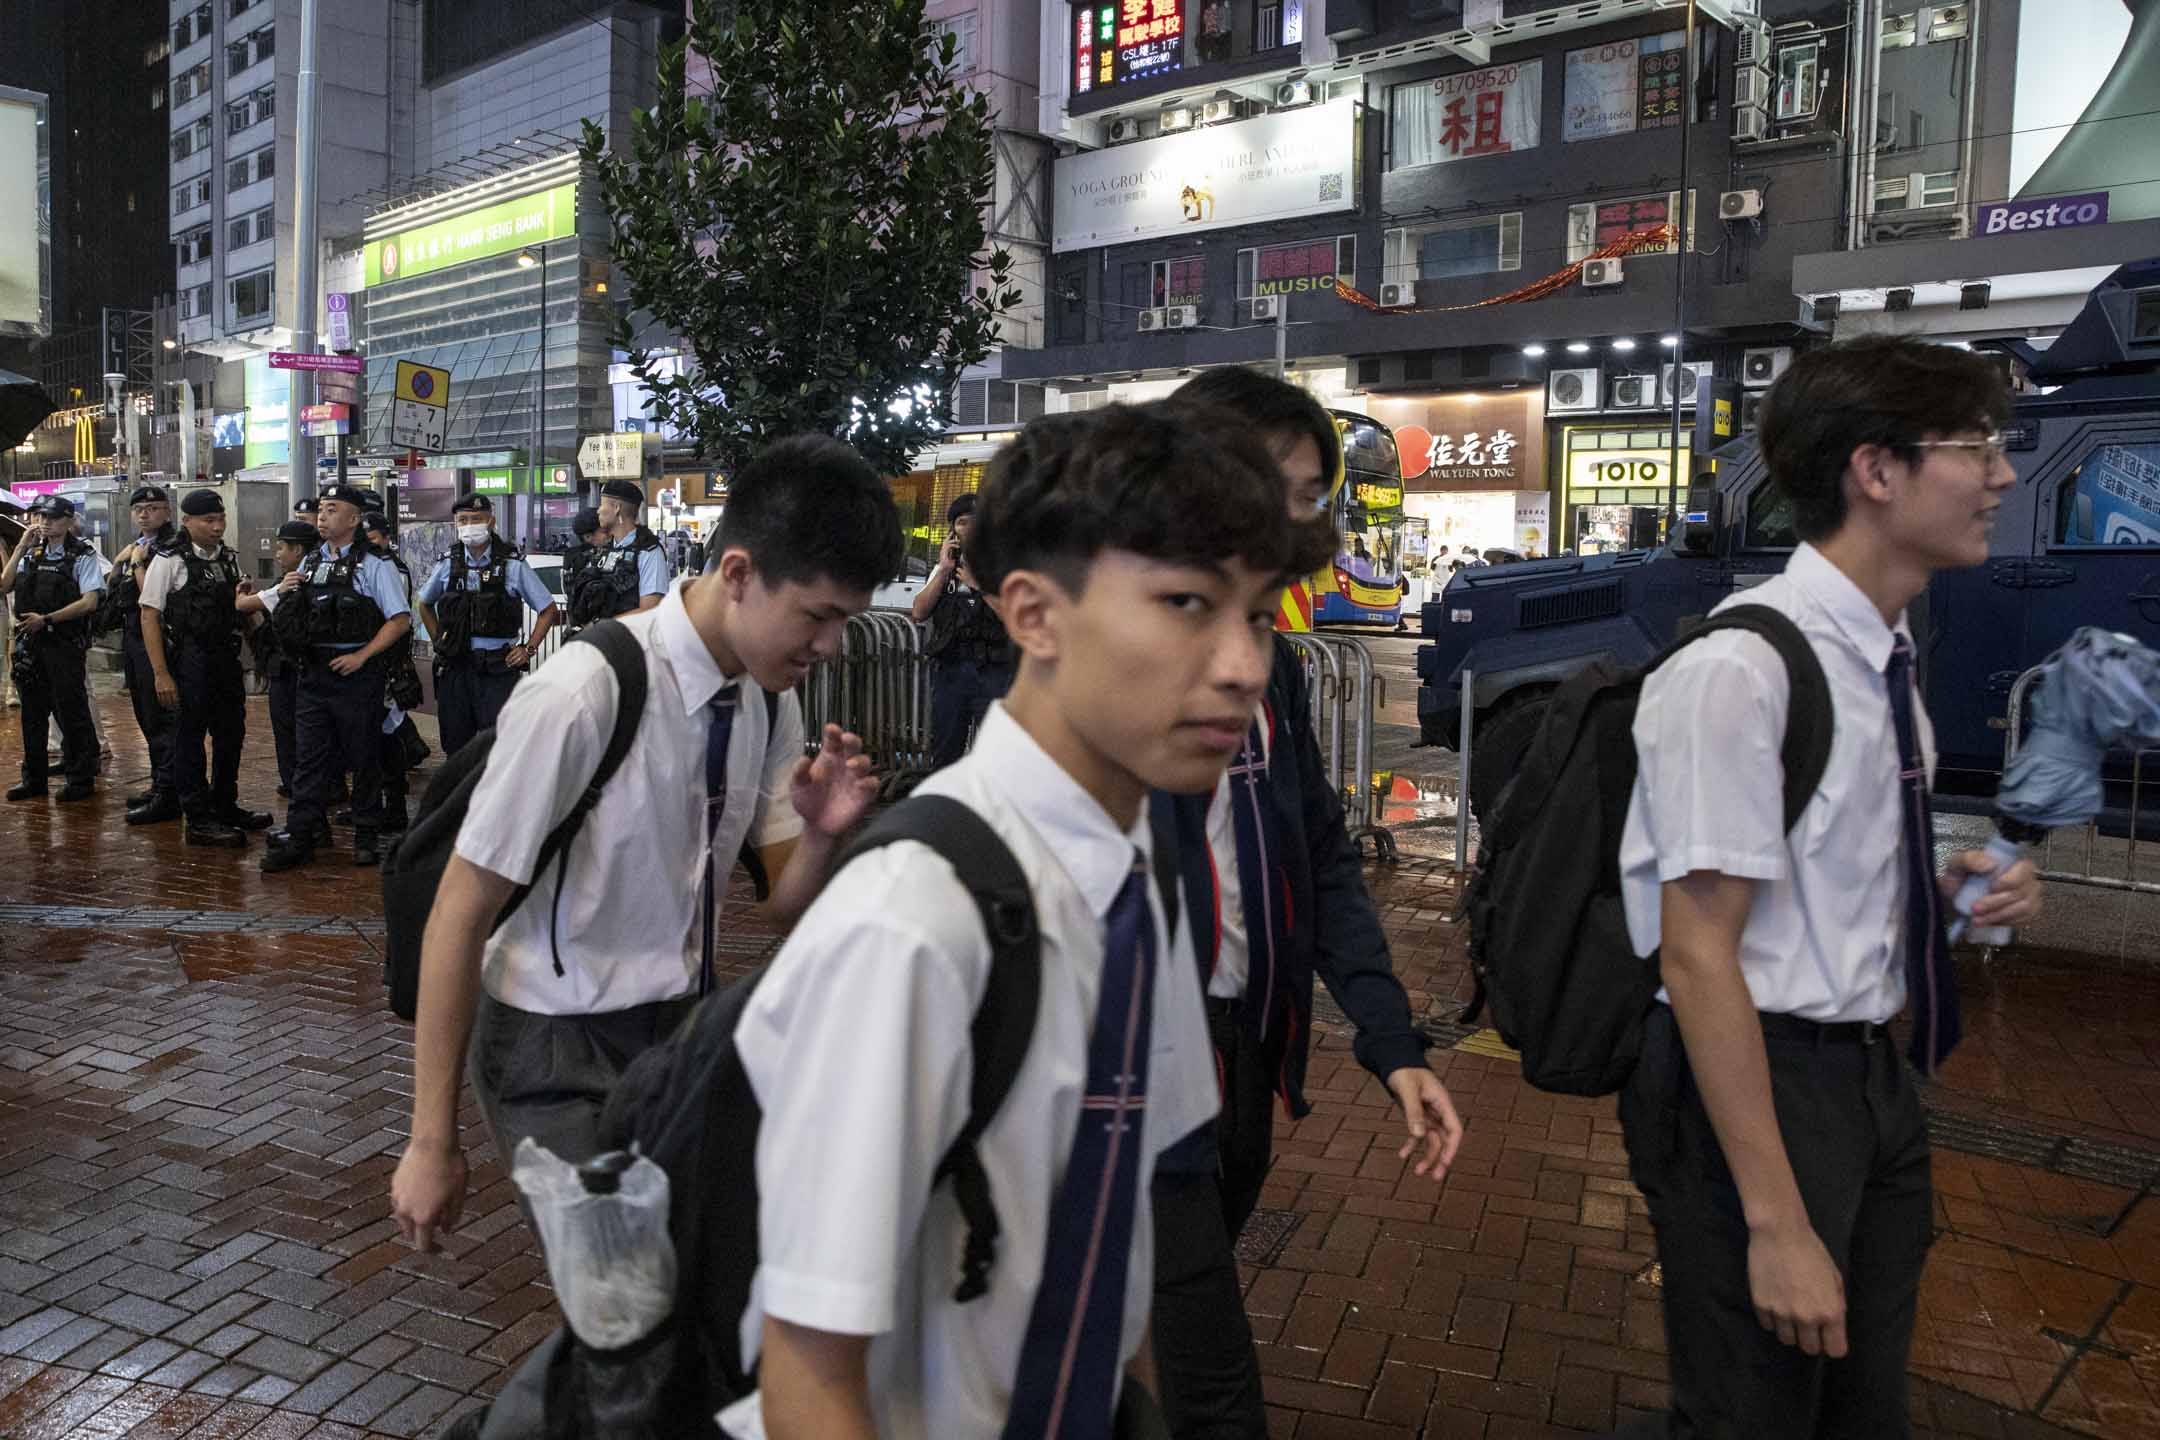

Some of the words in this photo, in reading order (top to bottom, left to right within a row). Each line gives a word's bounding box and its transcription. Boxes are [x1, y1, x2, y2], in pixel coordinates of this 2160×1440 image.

[1118, 16, 1181, 47] 駕駛學校
[1162, 37, 1180, 53] 17F
[1435, 66, 1518, 96] 91709520
[1438, 91, 1511, 155] 租
[1072, 180, 1106, 198] YOGA
[486, 221, 513, 241] SENG
[516, 211, 545, 233] BANK
[1985, 203, 2099, 234] Bestco
[1260, 275, 1334, 295] MUSIC
[428, 408, 435, 423] 7
[1715, 411, 1730, 426] 1010
[426, 433, 441, 448] 12
[589, 440, 600, 451] Yee
[616, 439, 637, 449] Street
[1430, 469, 1450, 479] WAI
[1451, 468, 1480, 478] YUEN
[1483, 467, 1516, 478] TONG
[1597, 462, 1658, 481] 1010
